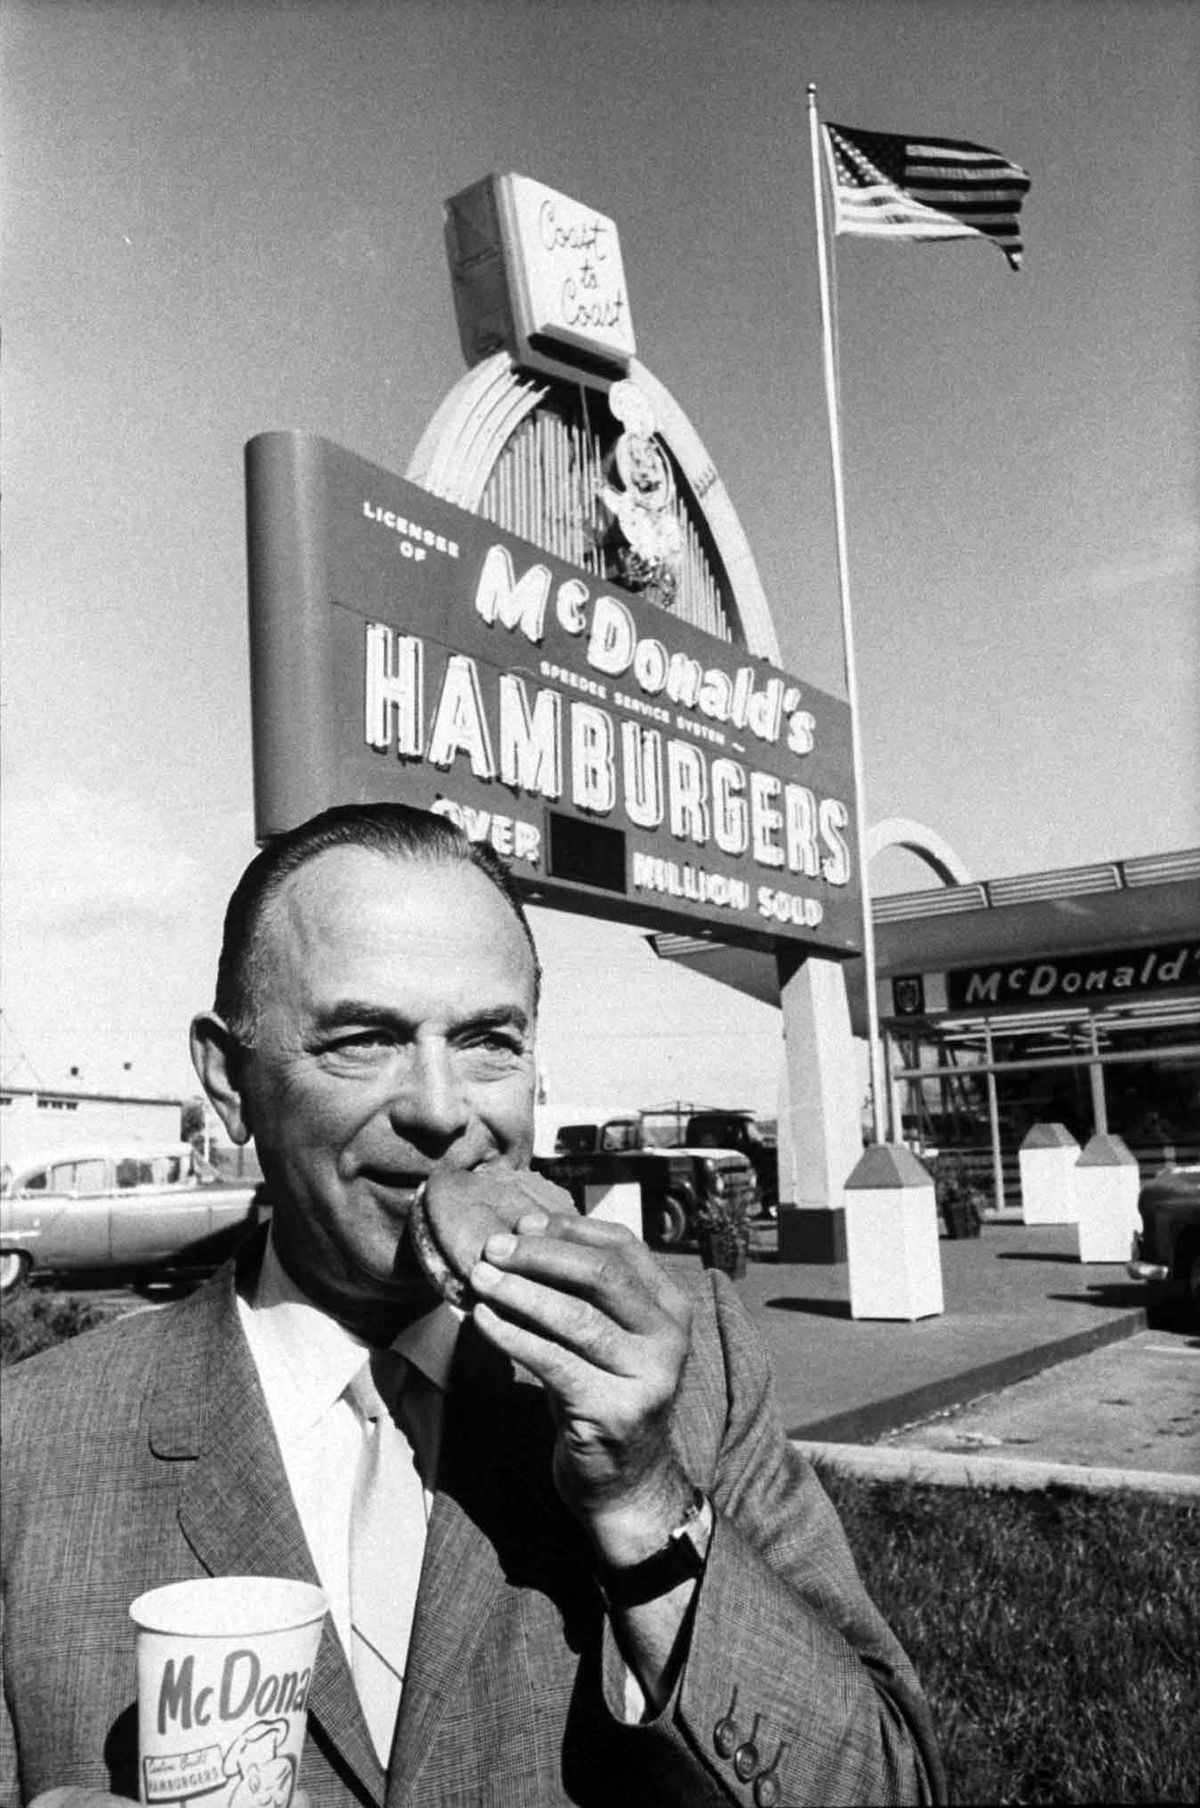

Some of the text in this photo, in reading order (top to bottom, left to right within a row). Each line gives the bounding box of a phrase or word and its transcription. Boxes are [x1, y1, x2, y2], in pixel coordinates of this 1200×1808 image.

[363, 501, 460, 559] LICENSEE
[400, 541, 427, 562] OF
[475, 544, 817, 755] McDonald's
[540, 660, 726, 746] SPEEDEE SERVICE SYSTEM
[364, 621, 851, 886] HAMBURGERS
[632, 852, 750, 911] MILLION
[757, 886, 824, 927] SOLD
